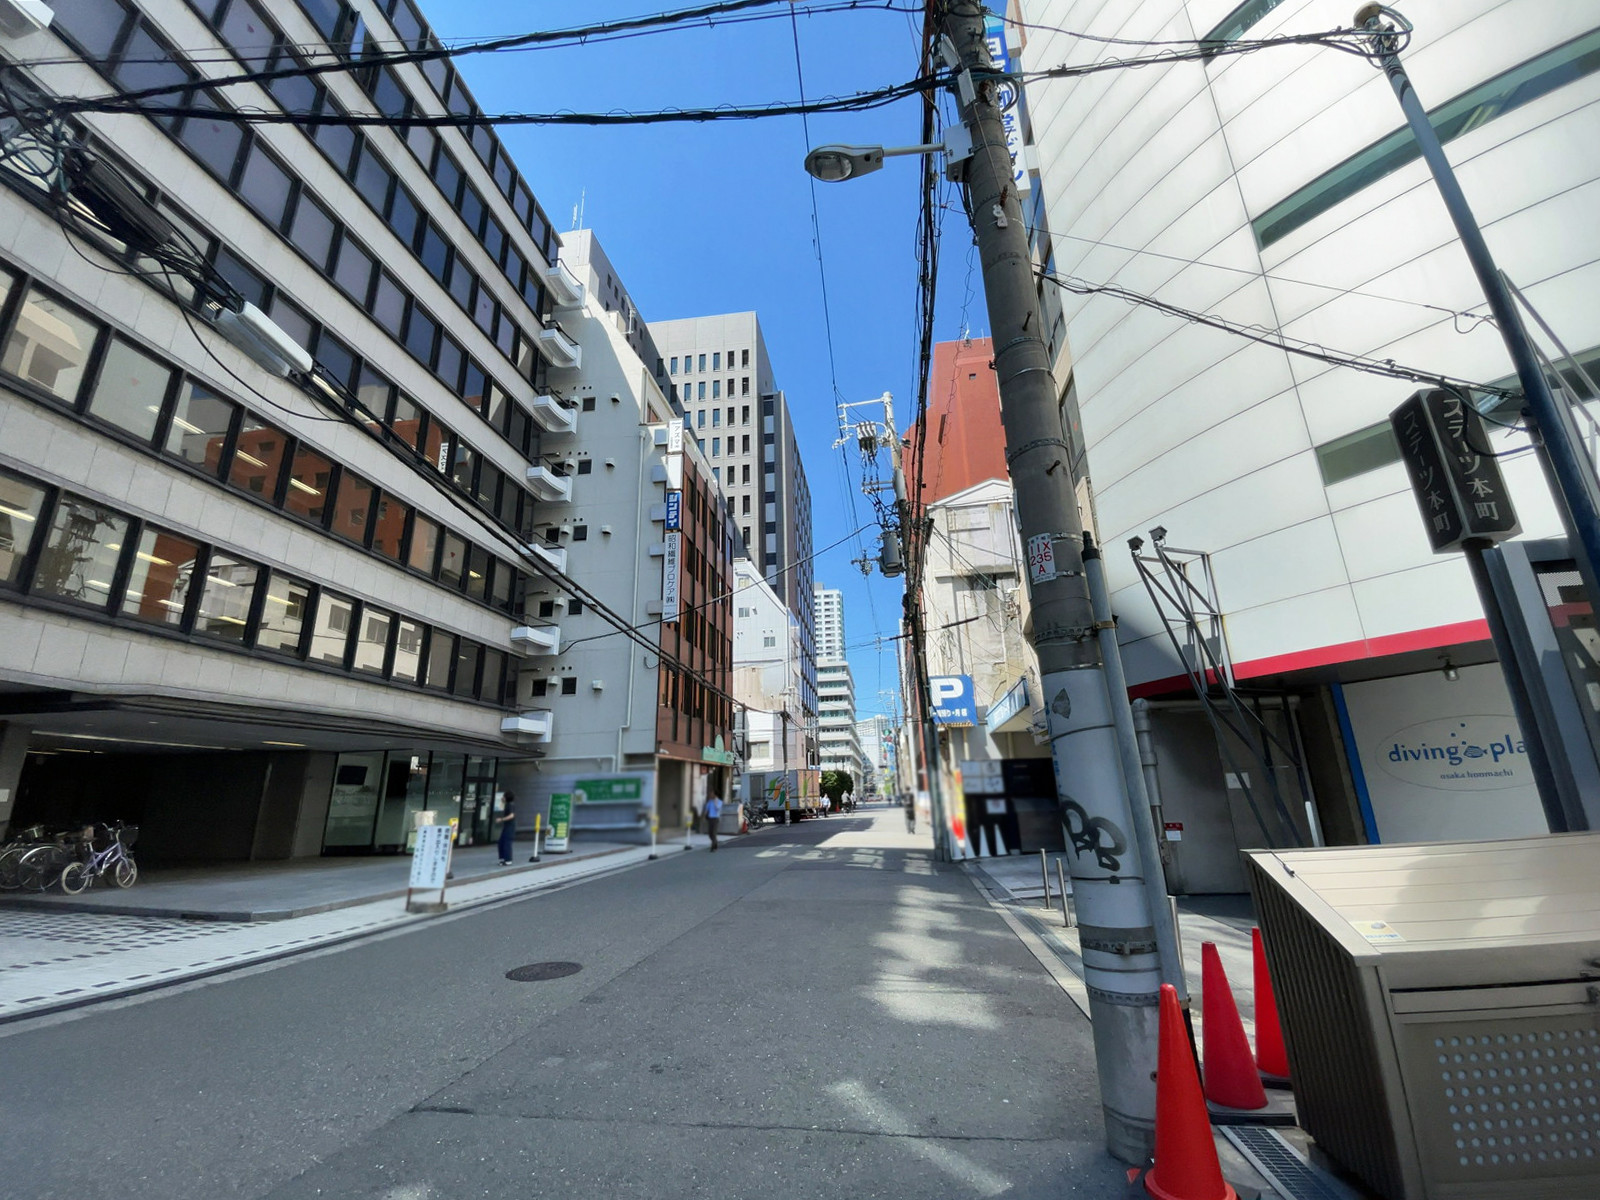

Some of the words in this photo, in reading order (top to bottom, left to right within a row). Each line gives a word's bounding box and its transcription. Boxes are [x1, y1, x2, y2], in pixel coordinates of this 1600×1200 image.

[1403, 410, 1451, 533] ステーツ本町
[1030, 552, 1053, 567] 235
[1038, 564, 1047, 575] A
[930, 677, 964, 706] P
[1388, 743, 1463, 766] diving
[1440, 772, 1466, 780] osaka
